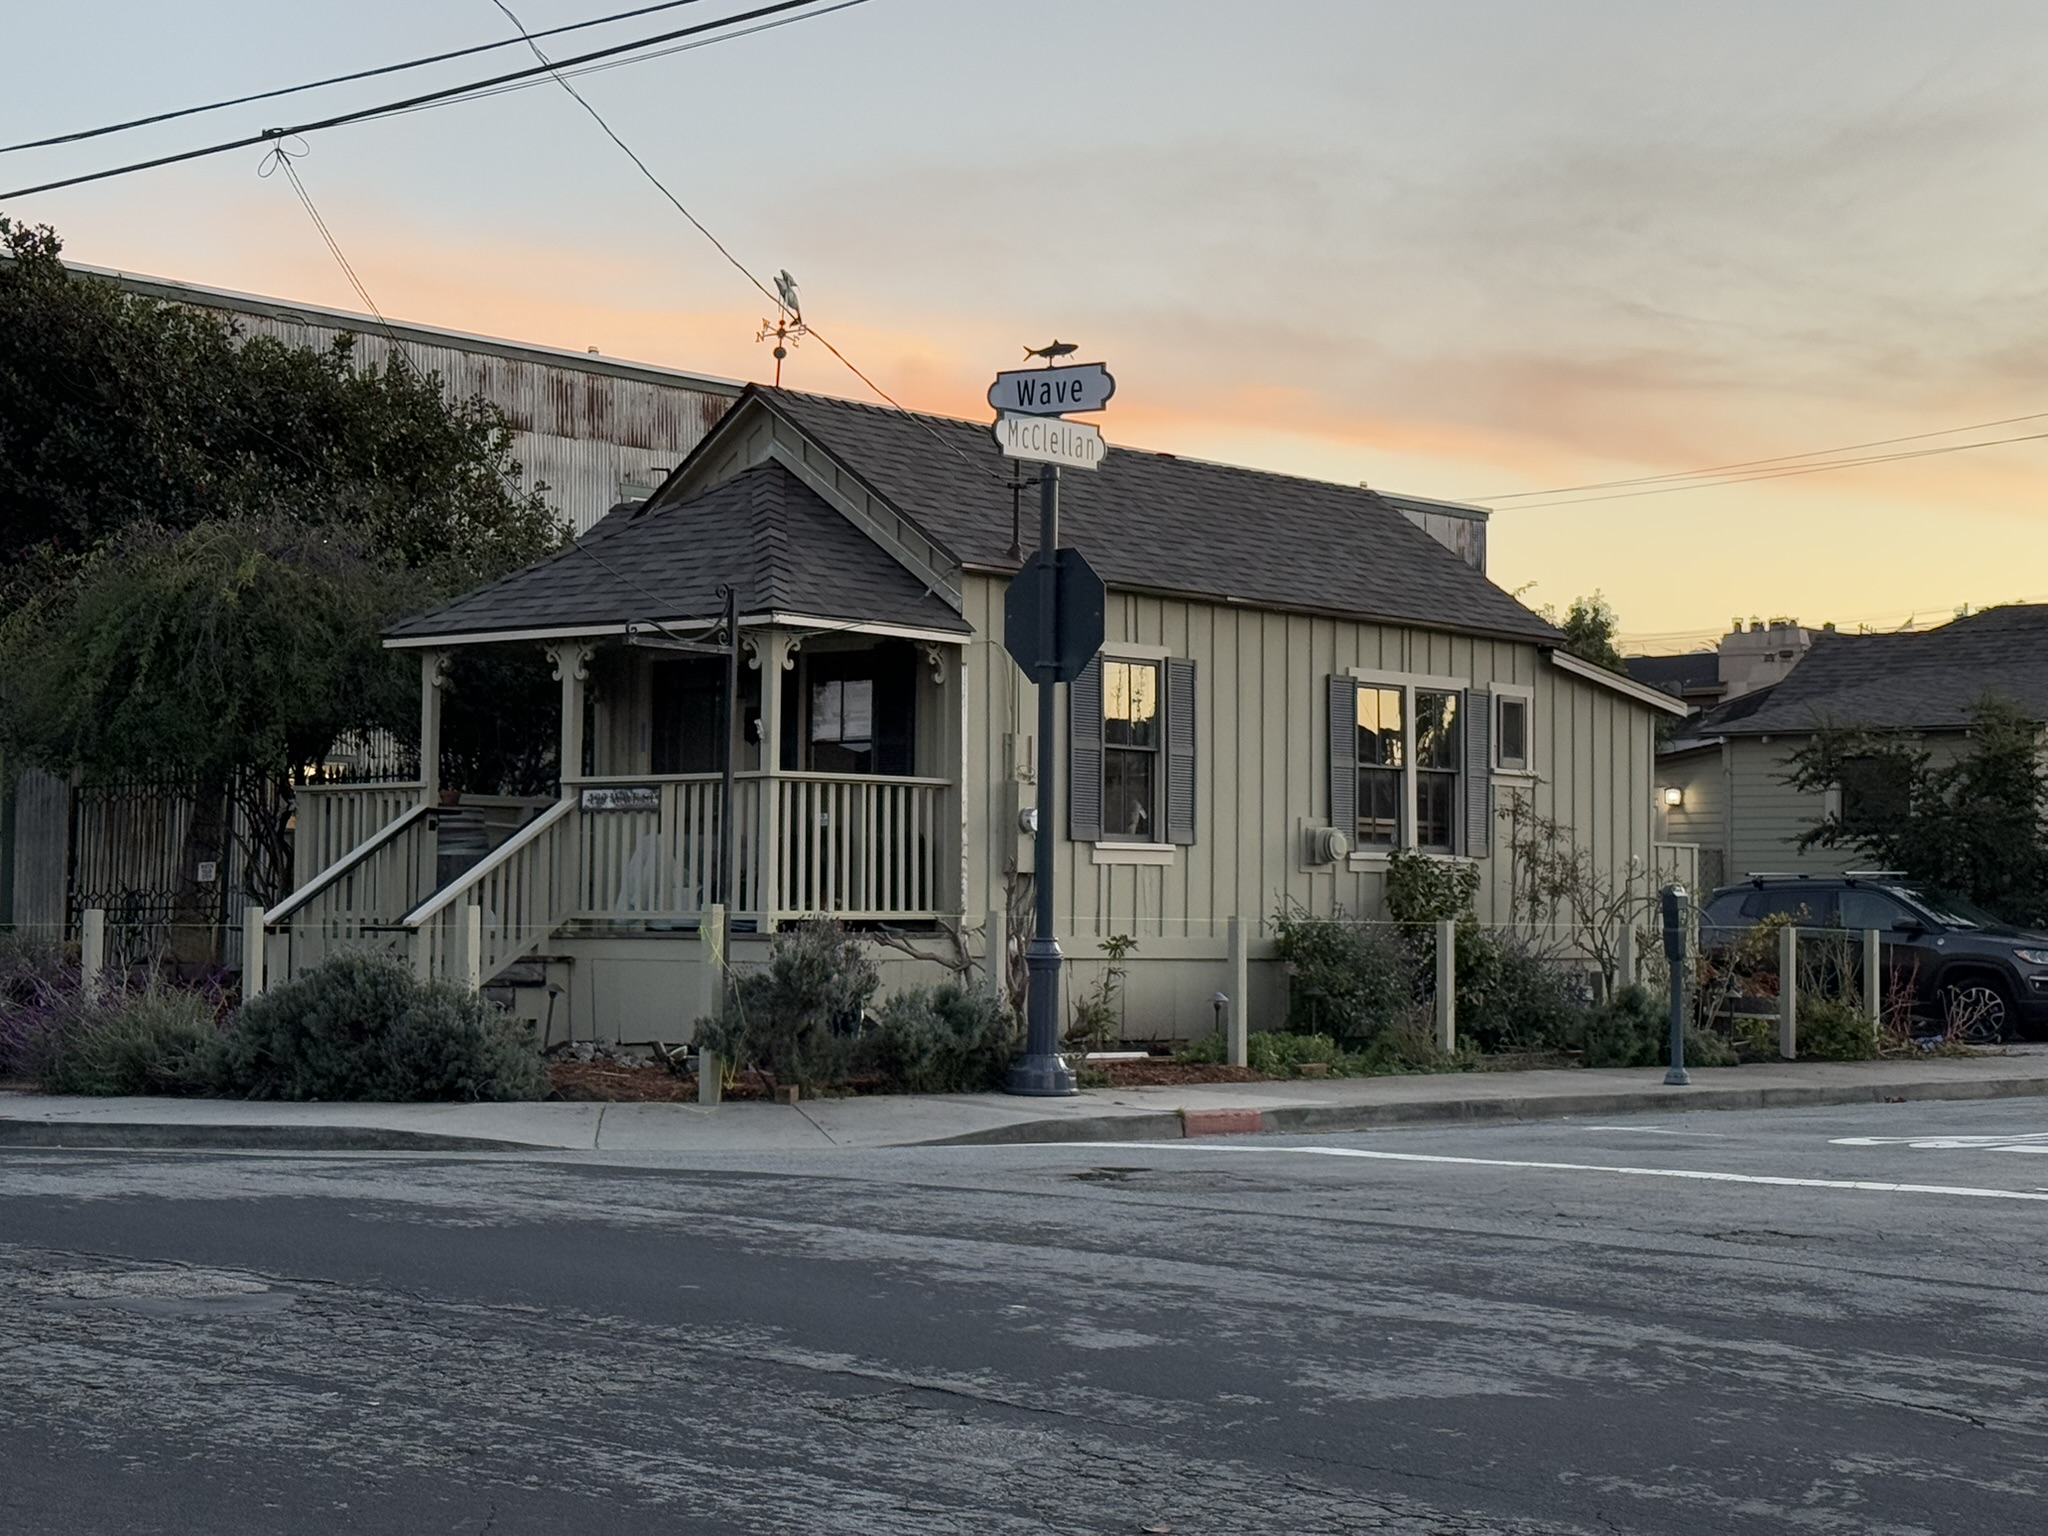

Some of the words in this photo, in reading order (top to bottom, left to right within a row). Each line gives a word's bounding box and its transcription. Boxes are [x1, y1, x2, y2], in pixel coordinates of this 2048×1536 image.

[756, 331, 765, 343] N
[1017, 379, 1083, 406] Wave
[1008, 419, 1095, 460] McClellan
